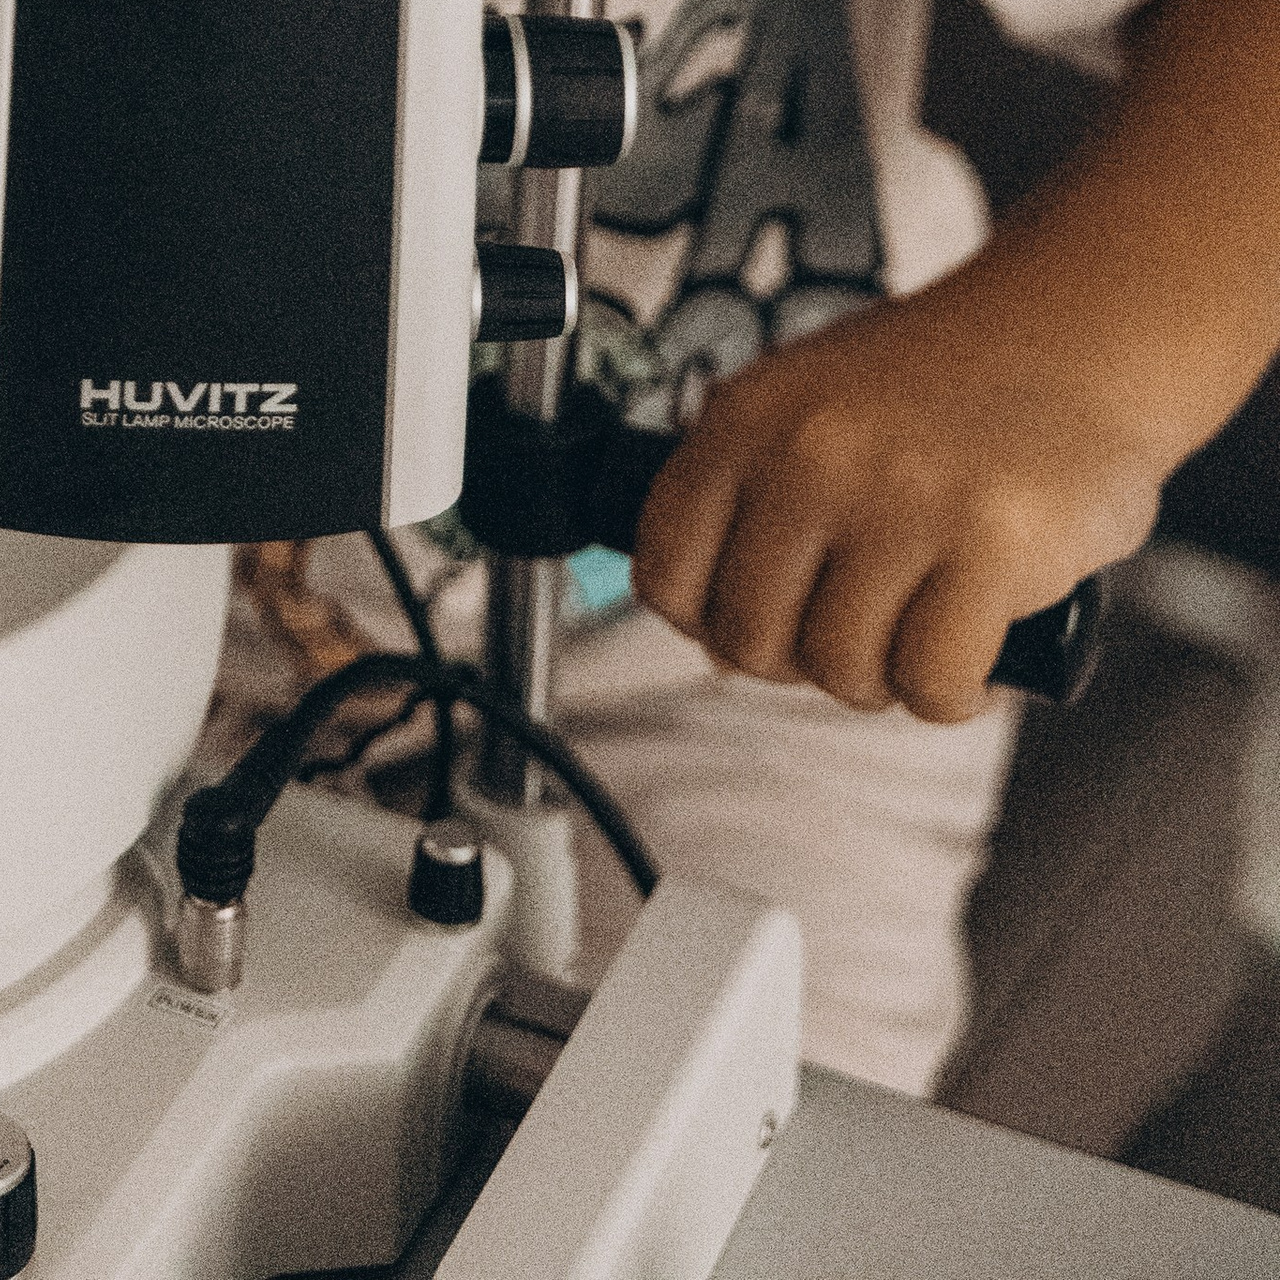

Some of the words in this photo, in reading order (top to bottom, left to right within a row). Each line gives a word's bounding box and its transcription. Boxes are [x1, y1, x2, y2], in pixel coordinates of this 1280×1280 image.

[79, 378, 298, 413] HUVITZ
[81, 412, 117, 427] SLIT
[122, 414, 171, 429] LAMP
[173, 415, 295, 430] MICROSCOPE
